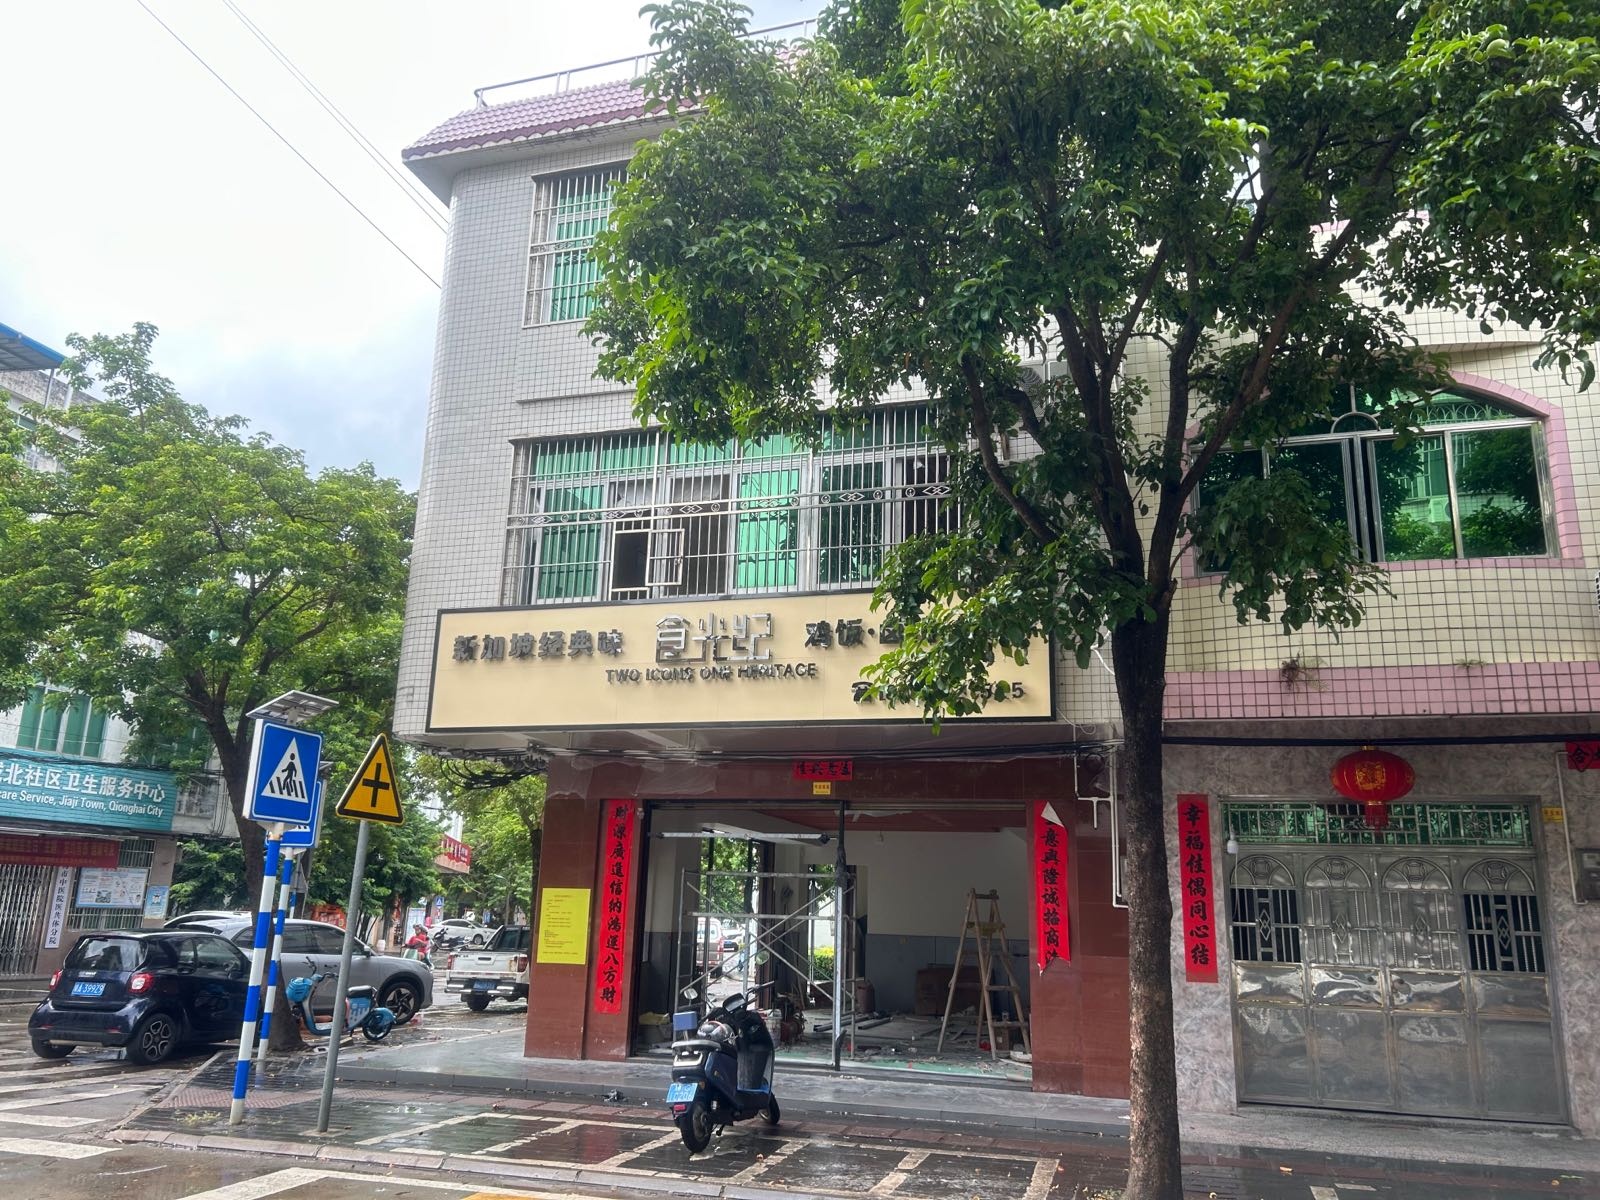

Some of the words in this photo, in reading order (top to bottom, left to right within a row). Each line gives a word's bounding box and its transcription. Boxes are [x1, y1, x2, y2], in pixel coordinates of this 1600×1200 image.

[453, 629, 624, 661] 新加坡经典味
[605, 667, 641, 683] TWO
[646, 666, 695, 681] ICONS
[700, 665, 733, 680] ONE
[738, 663, 818, 679] HERITAGE
[0, 790, 17, 801] are
[20, 790, 56, 806] Service,
[59, 795, 79, 809] Jiaji
[81, 797, 106, 811] Town,
[109, 800, 146, 816] Qionghai
[147, 804, 163, 818] City
